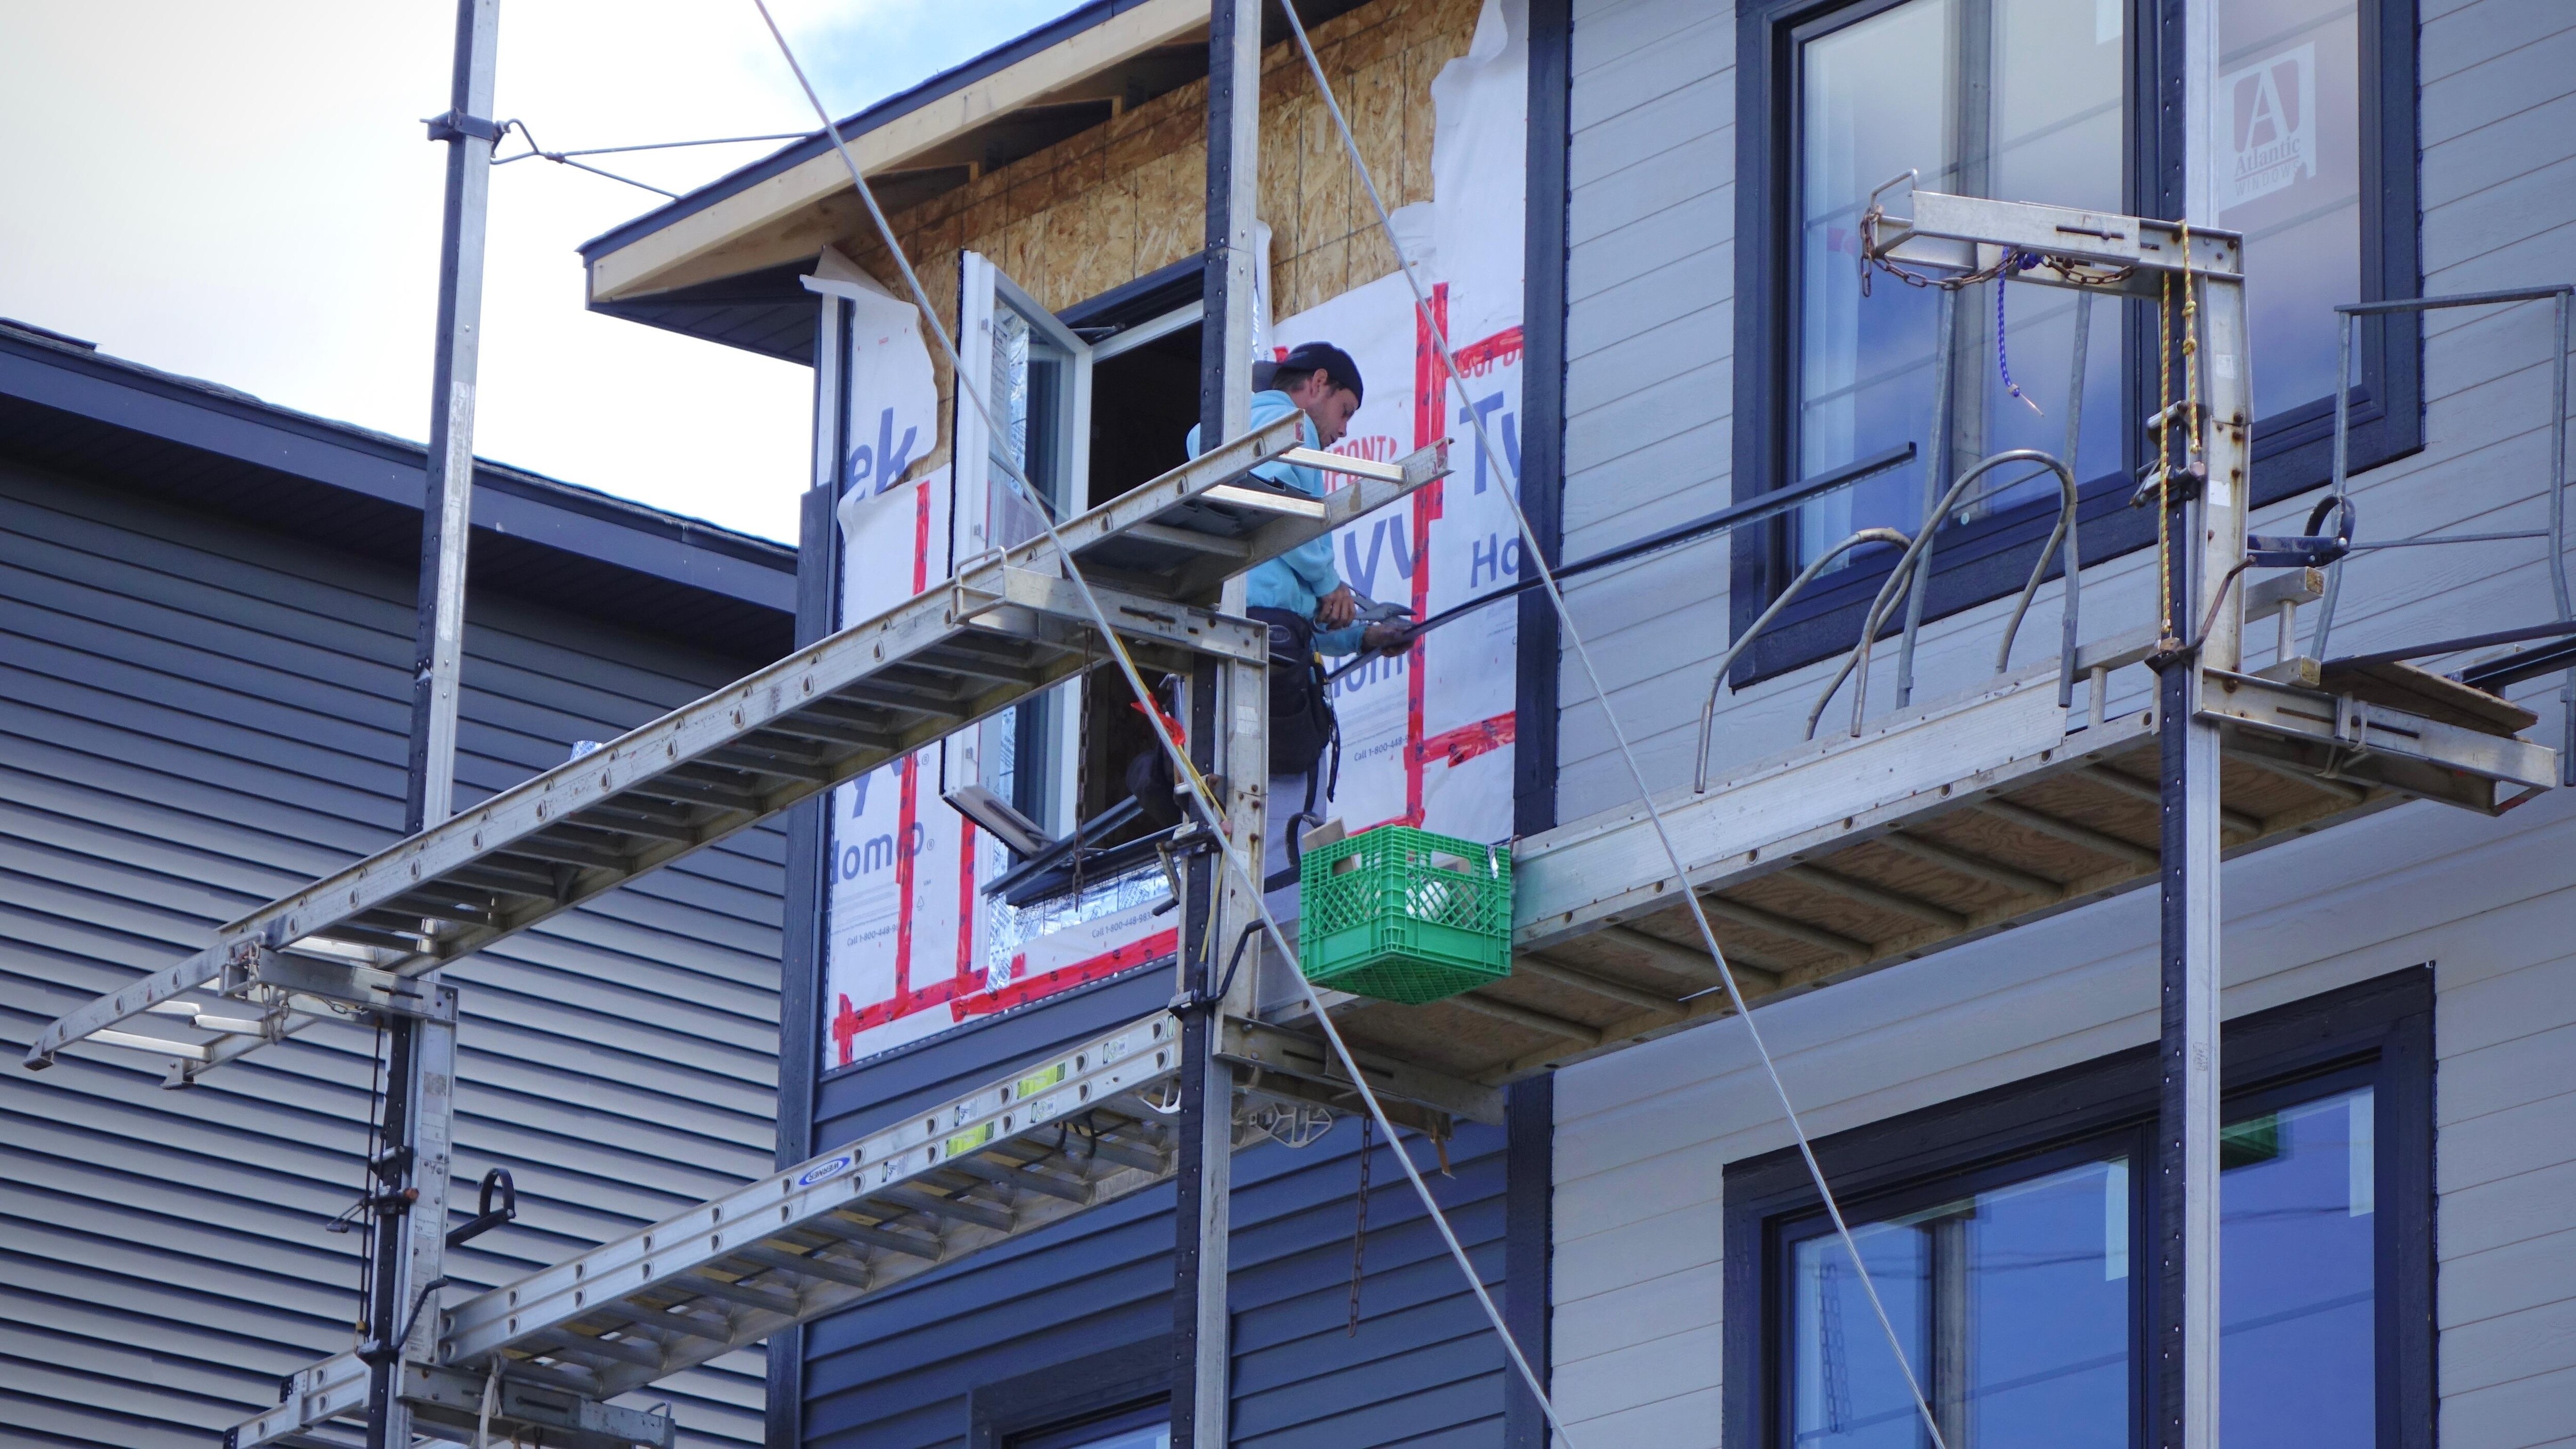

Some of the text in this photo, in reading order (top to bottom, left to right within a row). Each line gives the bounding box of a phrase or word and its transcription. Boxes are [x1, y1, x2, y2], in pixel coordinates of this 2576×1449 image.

[2234, 136, 2300, 178] Atlantic
[1354, 751, 1367, 761] Call
[1092, 927, 1104, 938] Call
[847, 934, 857, 946] Call
